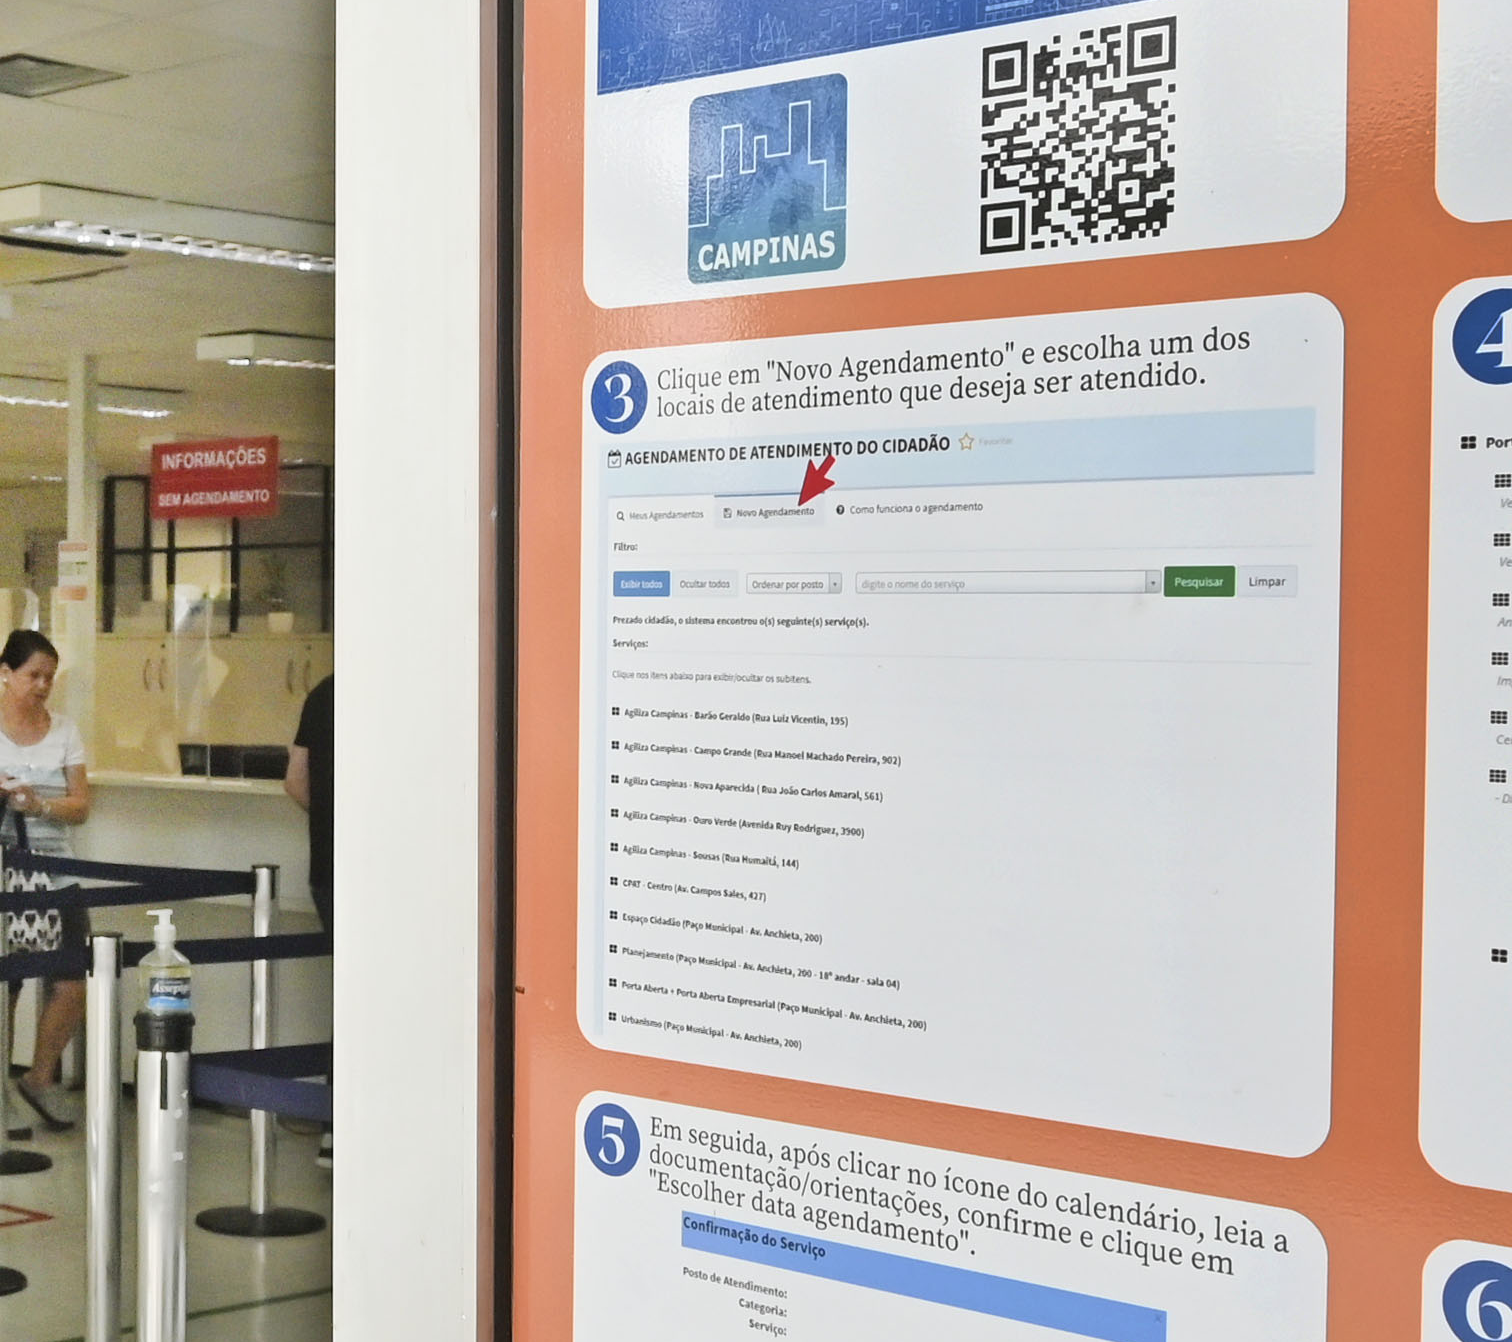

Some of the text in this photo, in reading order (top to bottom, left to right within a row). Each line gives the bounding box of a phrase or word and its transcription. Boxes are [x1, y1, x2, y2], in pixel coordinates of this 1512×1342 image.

[697, 230, 836, 281] CAMPINAS
[657, 325, 1250, 395] Clique em "Novo Agendamento" e escolha um dos
[604, 373, 635, 424] 3
[162, 446, 266, 470] INFORMAÇÕES
[624, 433, 950, 465] AGENDAMENTO DE ATENDIMENTO DO CIDADÃO
[1174, 577, 1224, 590] Pesquisar
[1249, 577, 1286, 589] Limpar
[598, 1115, 625, 1164] 5
[649, 1168, 976, 1256] "Escolher data agendamento".
[681, 1214, 826, 1260] Confirmação do Serviço
[738, 1297, 788, 1318] Categoria:
